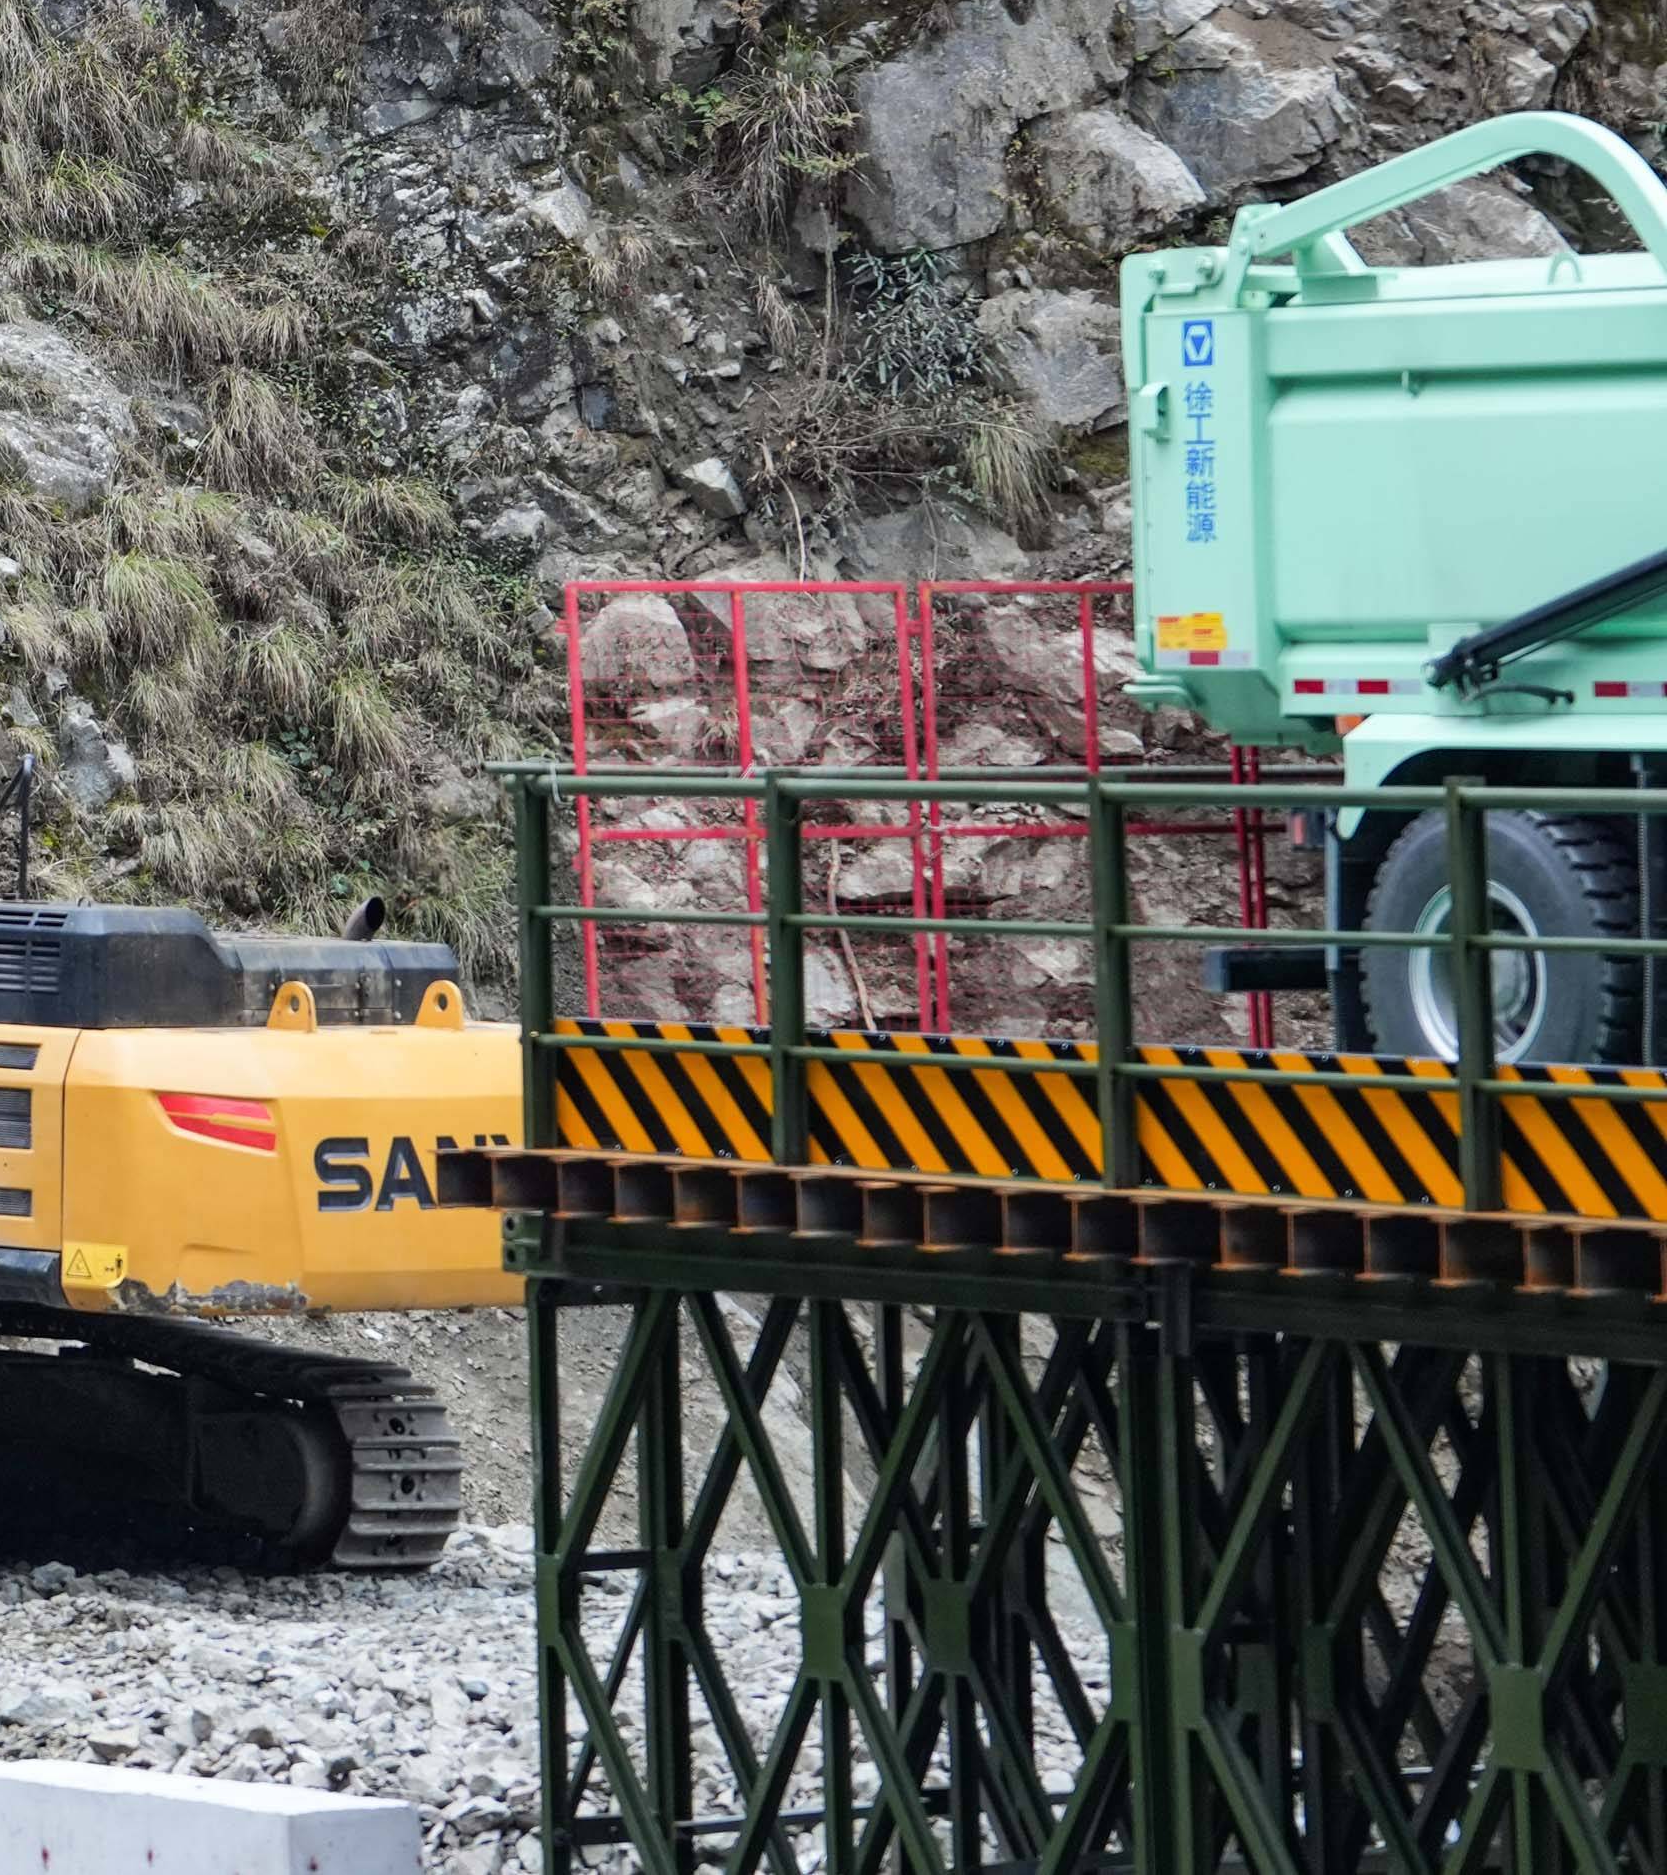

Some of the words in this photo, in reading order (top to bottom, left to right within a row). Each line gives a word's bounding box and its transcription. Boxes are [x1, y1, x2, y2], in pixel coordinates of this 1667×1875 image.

[1183, 380, 1217, 543] 徐工新能源
